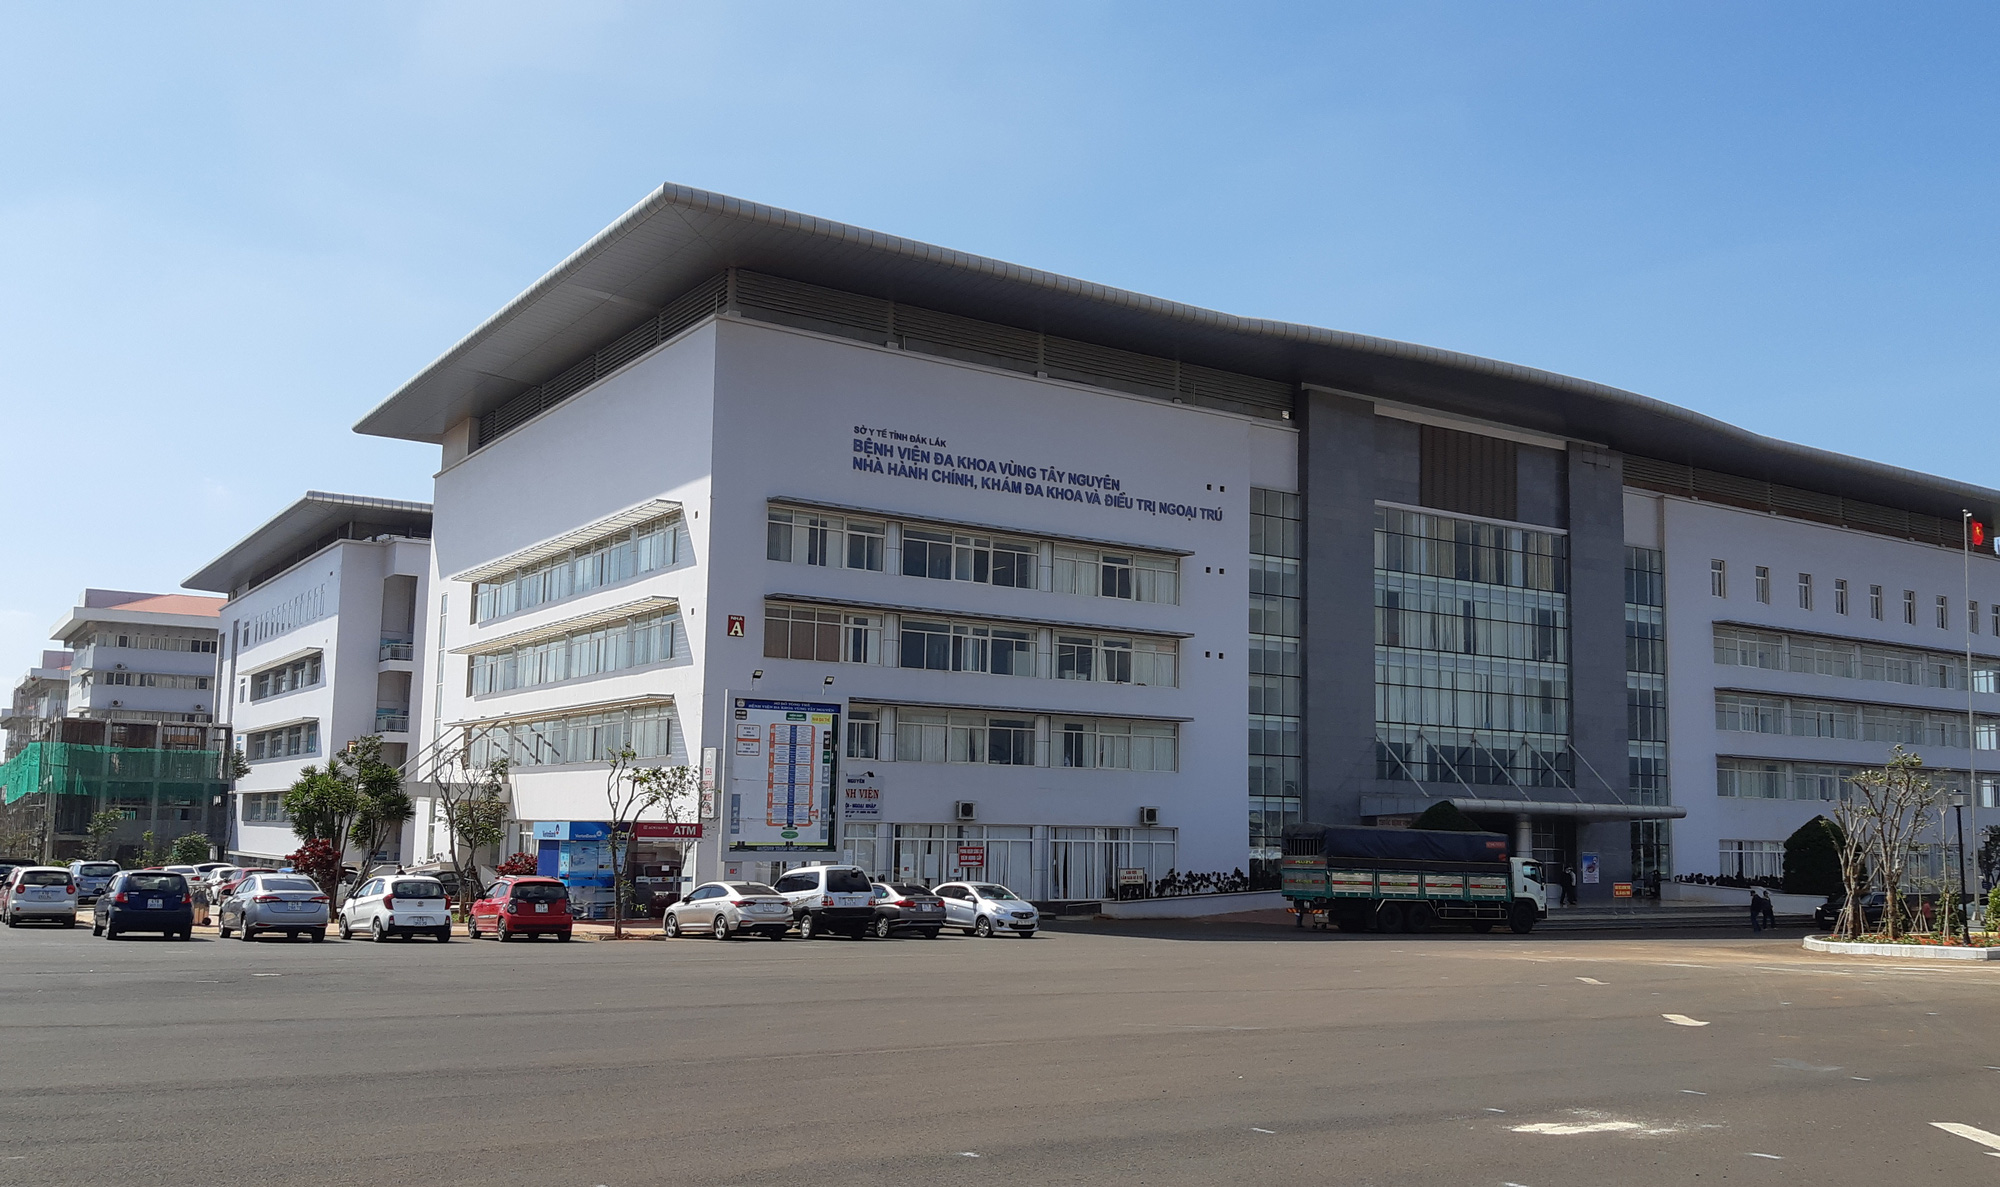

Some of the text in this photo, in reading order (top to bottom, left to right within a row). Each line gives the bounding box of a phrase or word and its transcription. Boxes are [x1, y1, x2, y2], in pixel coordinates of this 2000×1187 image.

[853, 425, 947, 448] SỞ Y TẾ TỈNH ĐẮK LẮK
[853, 438, 1120, 491] BỆNH VIỆN ĐA KHOA VÙNG TÂY NGUYÊN
[852, 456, 1223, 521] NHÀ HÀNH CHÍNH, KHÁM ĐA KHOA VÀ ĐIỀU TRỊ NGOẠI TRÚ
[729, 621, 744, 637] A
[845, 786, 880, 801] NH VIỆN
[673, 826, 697, 836] ATM
